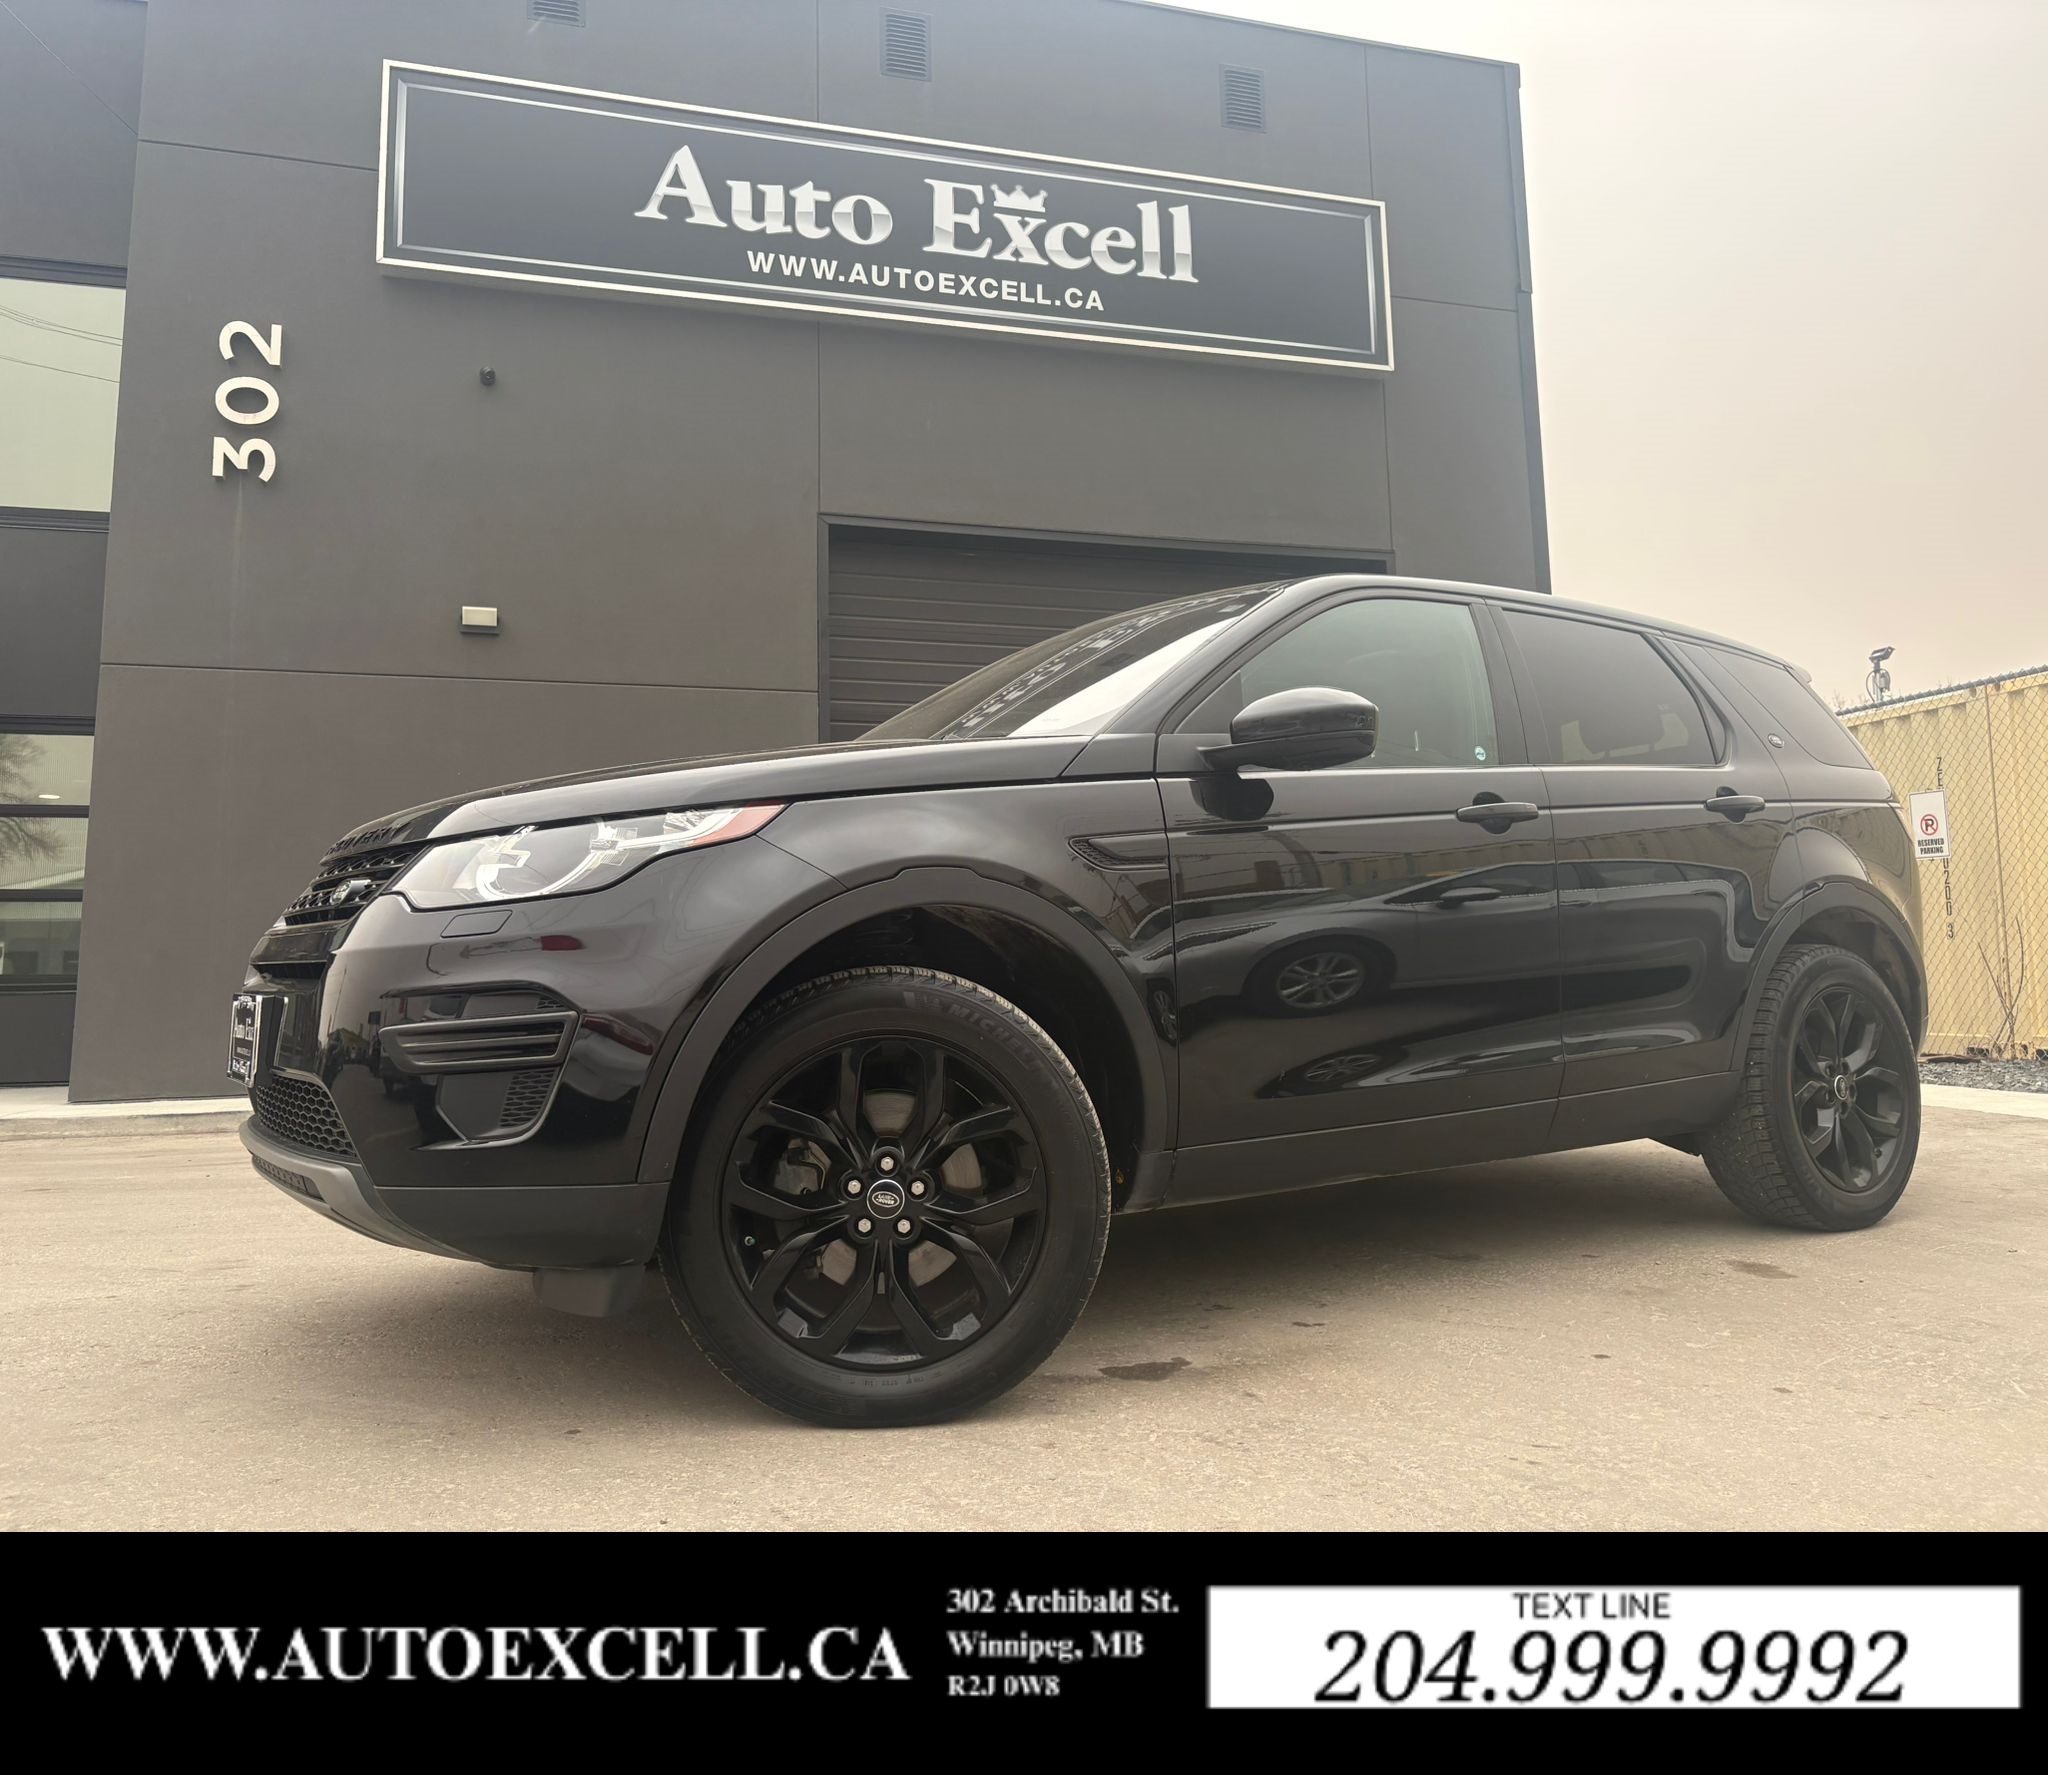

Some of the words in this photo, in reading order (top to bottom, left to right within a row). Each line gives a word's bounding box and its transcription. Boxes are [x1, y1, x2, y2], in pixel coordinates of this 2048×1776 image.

[634, 144, 893, 245] Auto
[922, 178, 1199, 283] Excell
[747, 250, 1105, 311] WWW.AUTOEXCELL.CA
[212, 320, 283, 482] 302
[1917, 838, 1945, 847] RESERVED
[1920, 847, 1944, 855] PARKING
[947, 1002, 1048, 1070] MICHEL
